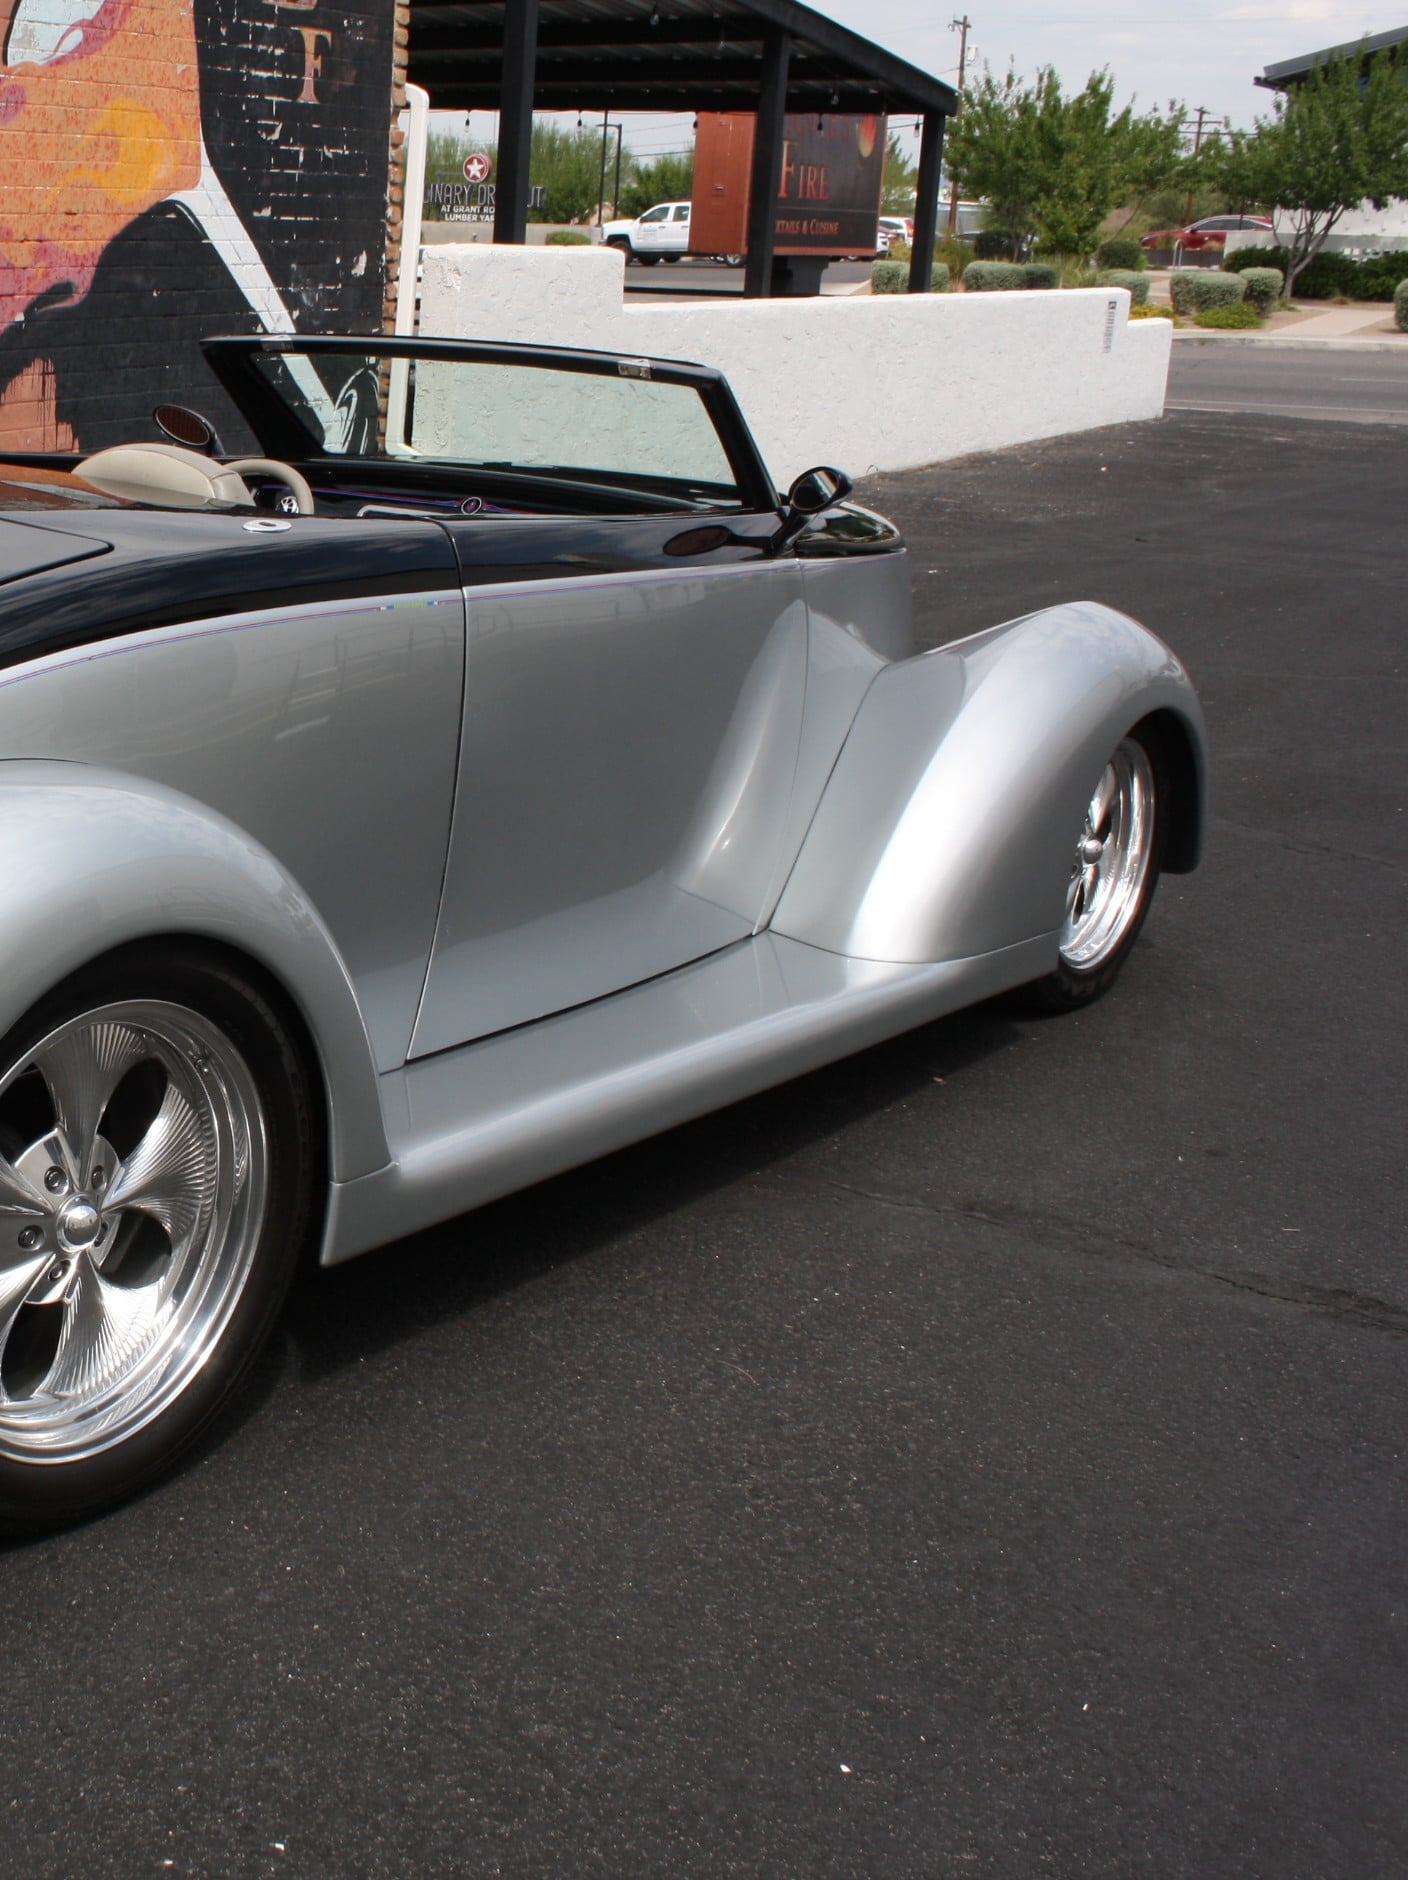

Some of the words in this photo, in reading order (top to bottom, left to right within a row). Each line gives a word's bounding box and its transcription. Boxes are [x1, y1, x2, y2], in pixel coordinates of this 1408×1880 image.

[777, 140, 830, 200] FIRE
[424, 183, 471, 205] INARY
[441, 205, 451, 213] AT
[453, 205, 481, 213] GRANT
[482, 205, 496, 214] RO
[444, 213, 477, 222] LUMBER
